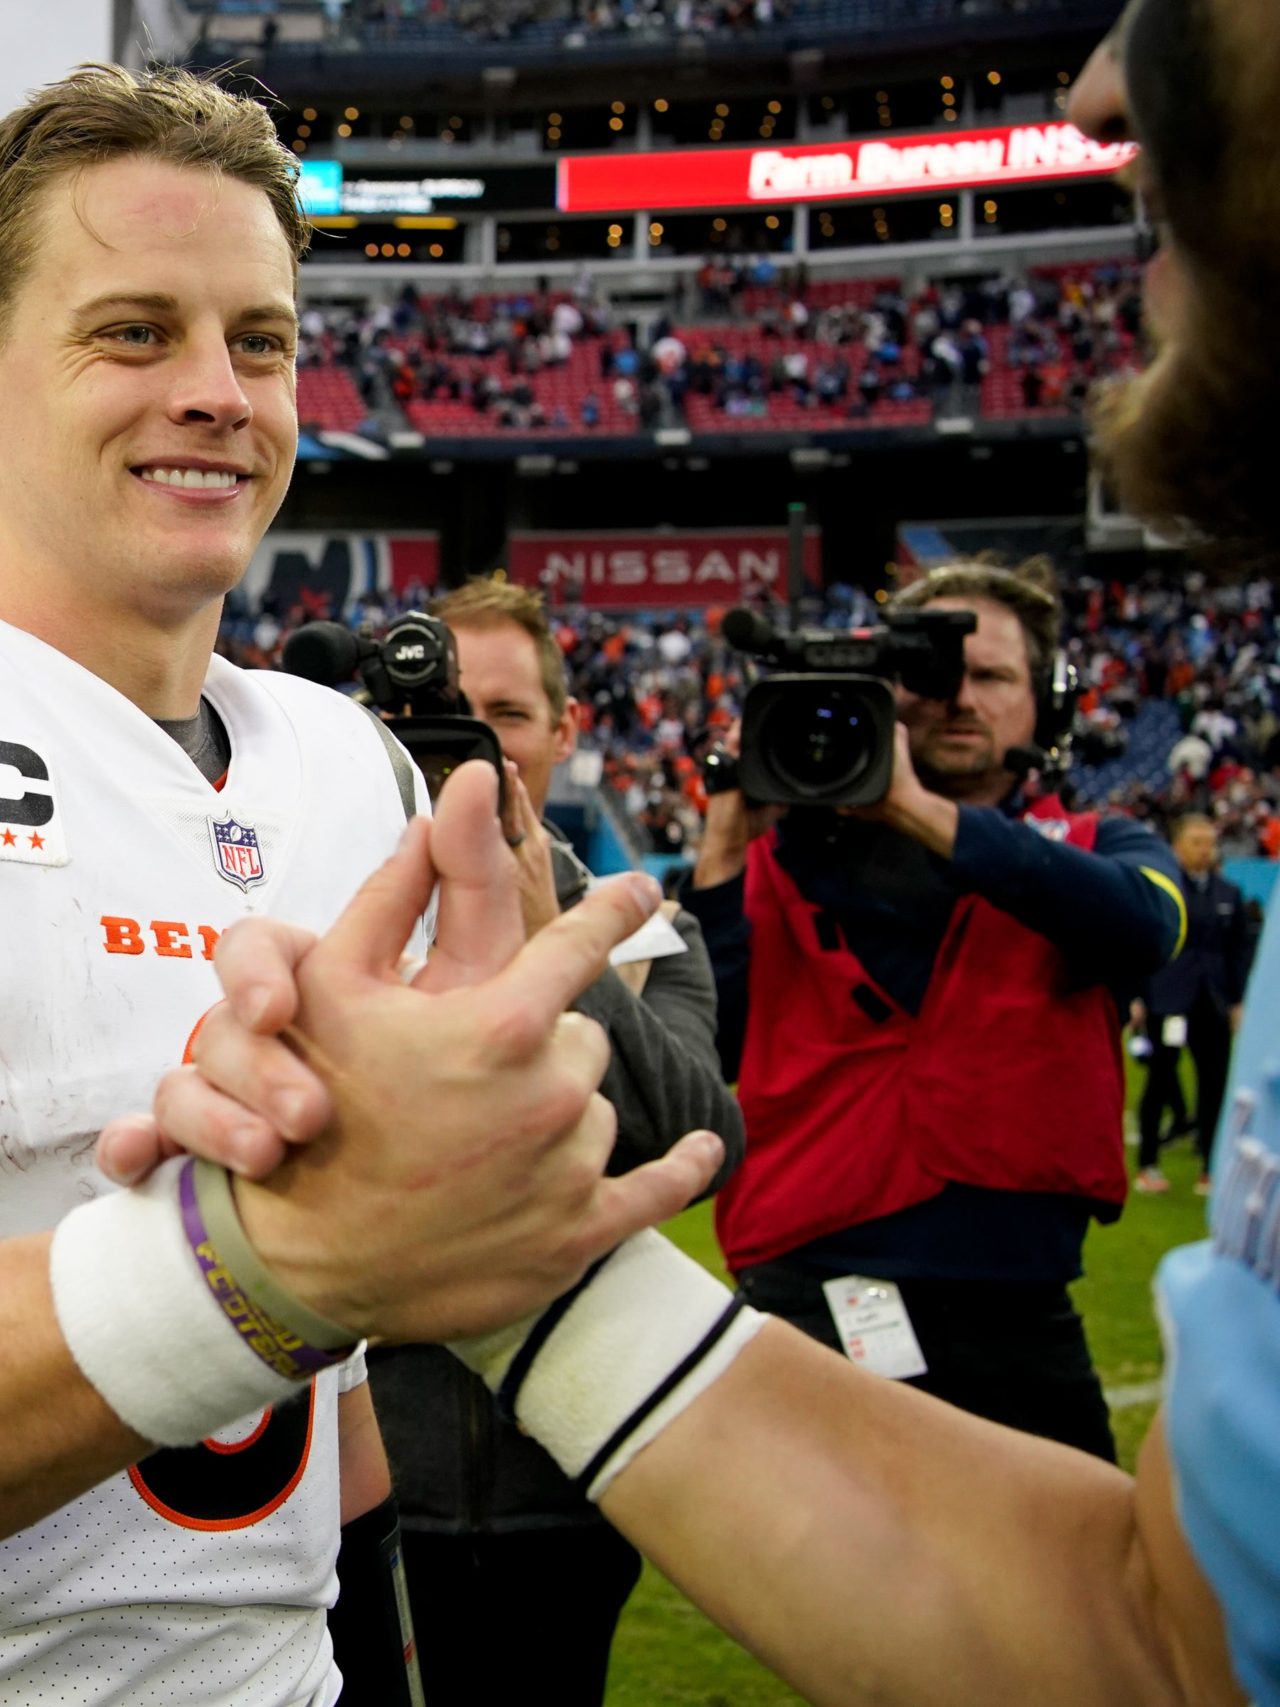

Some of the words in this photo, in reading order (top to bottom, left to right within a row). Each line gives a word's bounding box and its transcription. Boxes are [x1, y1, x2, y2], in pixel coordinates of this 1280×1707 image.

[748, 150, 854, 192] Farm
[857, 141, 1005, 184] Bureau
[544, 550, 780, 586] NISSAN
[395, 644, 425, 660] JVC
[222, 844, 260, 878] NFL
